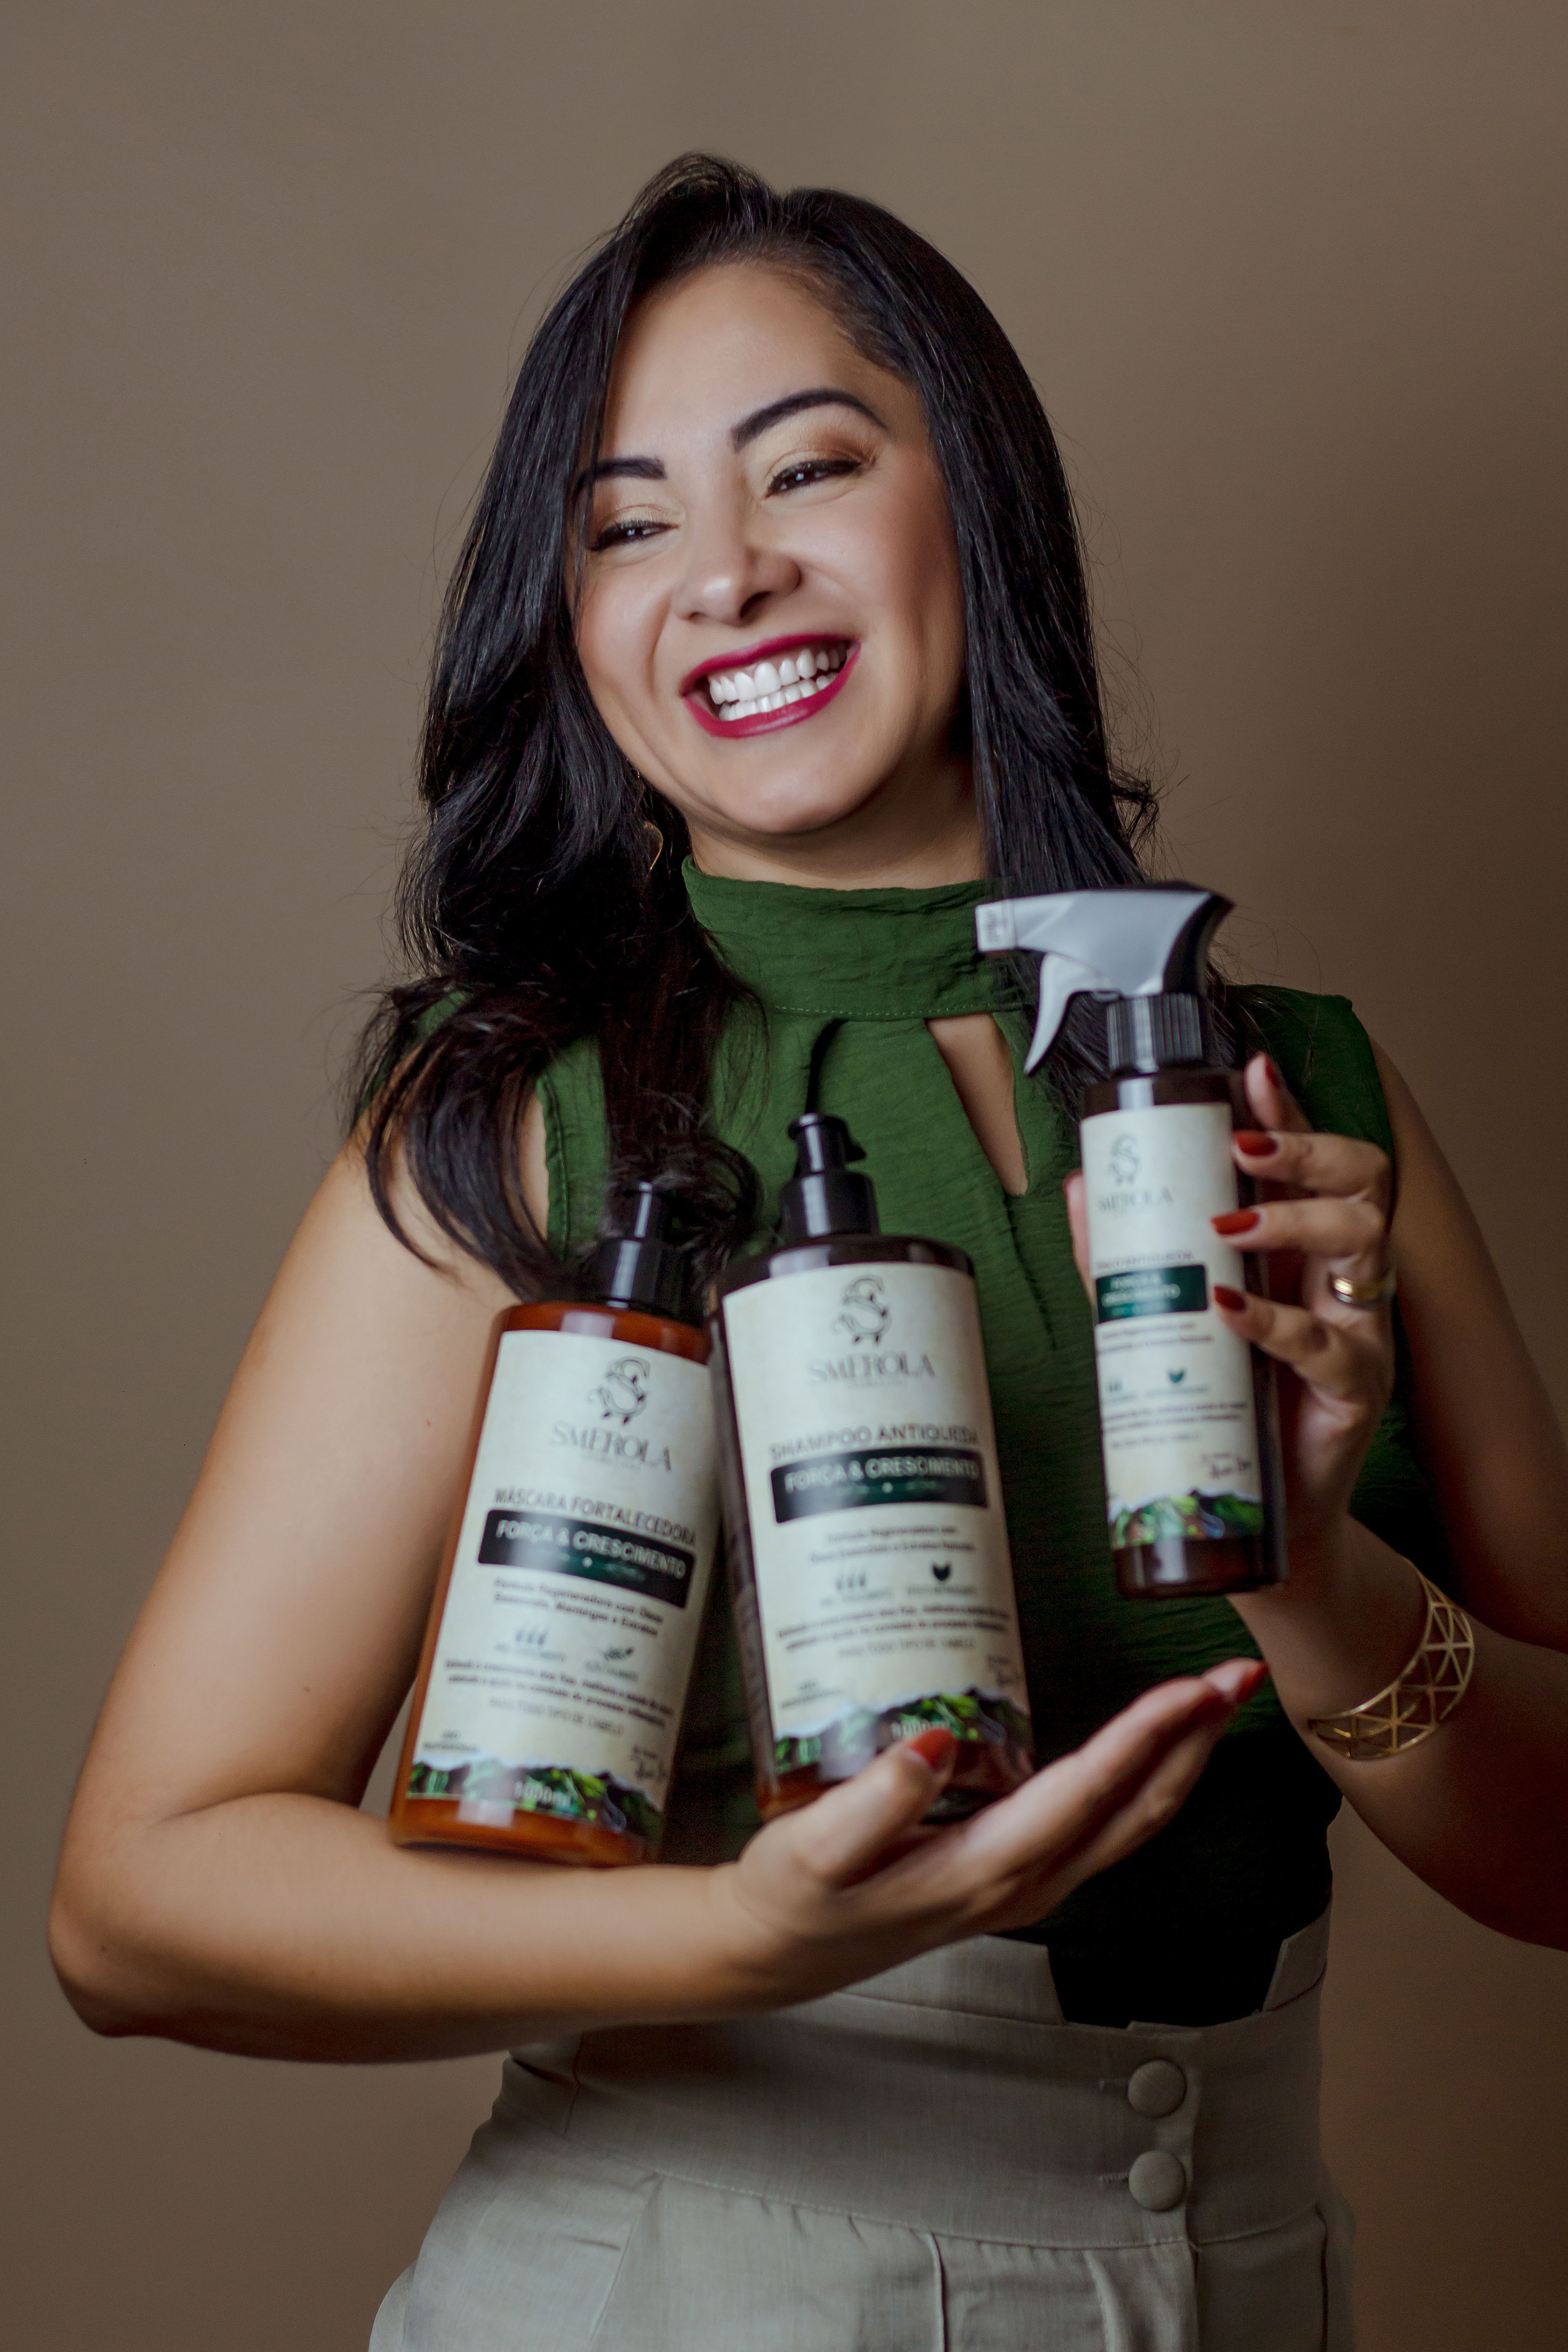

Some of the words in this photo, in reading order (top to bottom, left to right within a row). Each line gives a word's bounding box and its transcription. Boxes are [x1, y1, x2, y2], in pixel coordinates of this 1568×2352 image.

[769, 1426, 871, 1458] SHAMPOO
[878, 1423, 979, 1445] ANTIQUEDA
[785, 1463, 846, 1493] FORÇA
[865, 1456, 979, 1479] CRESCIMENTO
[496, 1486, 568, 1511] MÁSCARA
[570, 1496, 697, 1546] FORTALECEDORA
[496, 1519, 554, 1542] FORÇA
[572, 1530, 687, 1580] CRESCIMENTO
